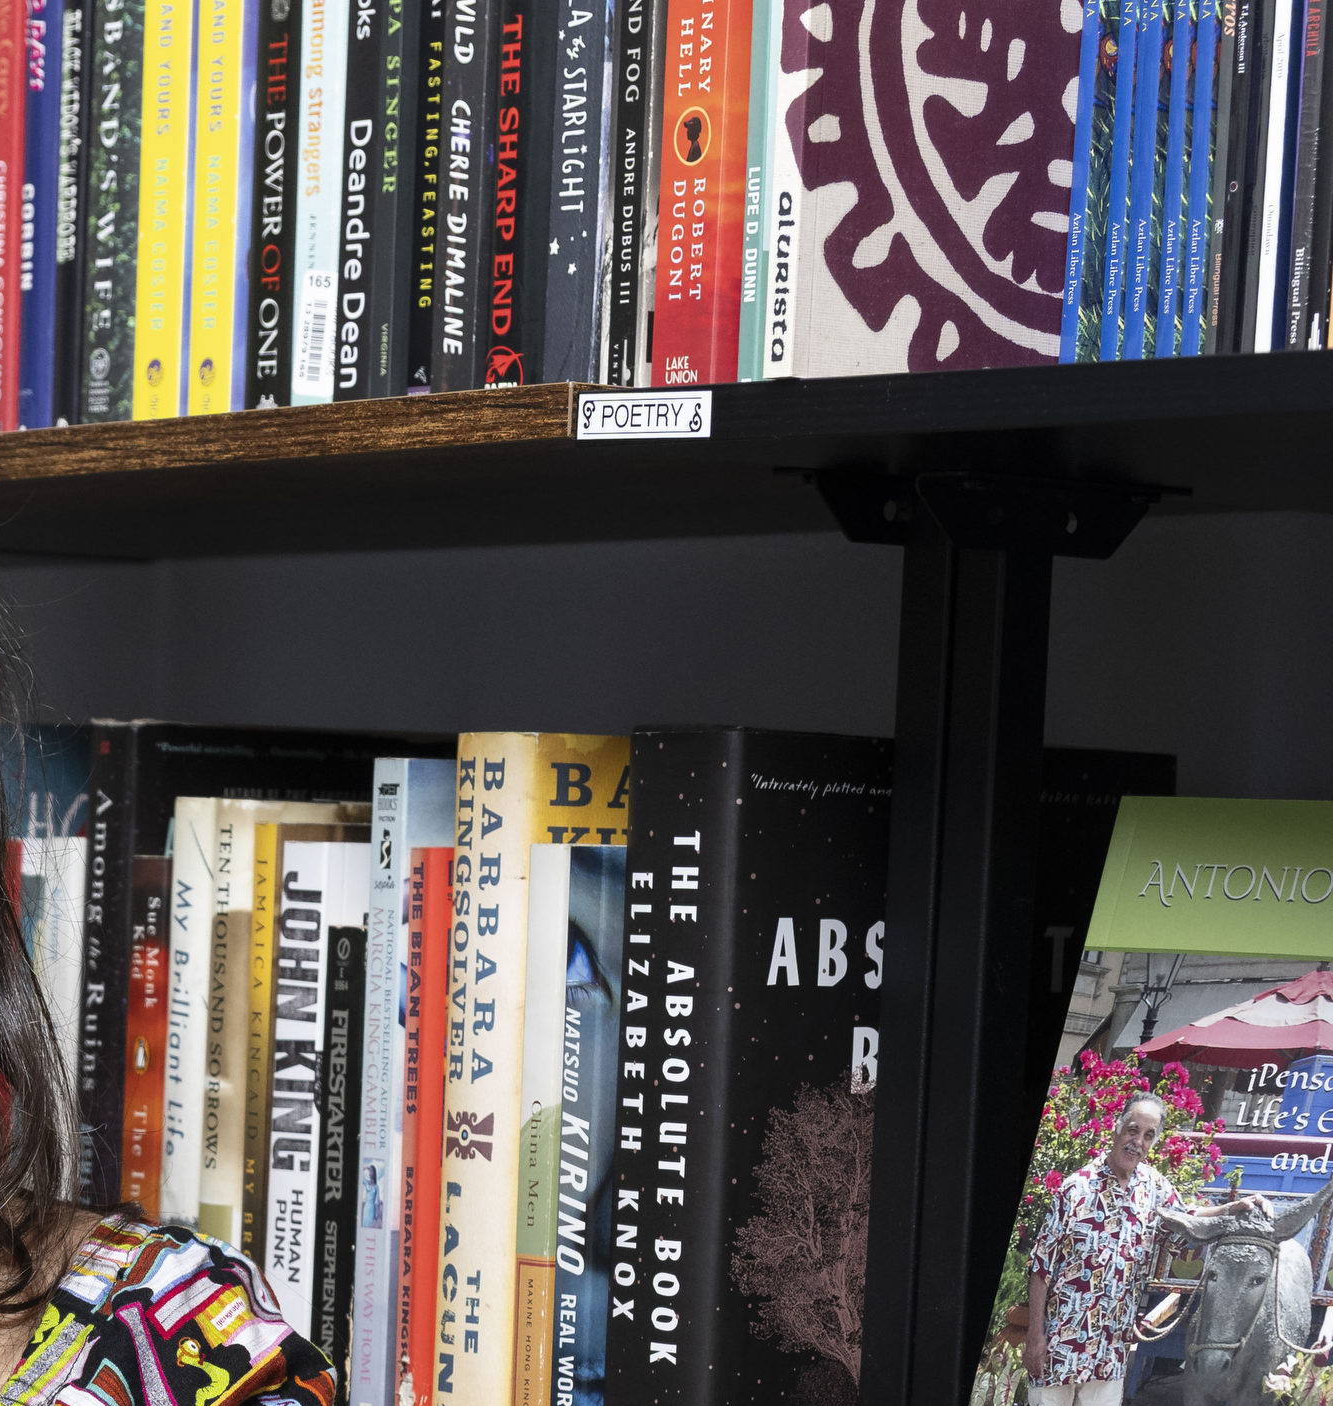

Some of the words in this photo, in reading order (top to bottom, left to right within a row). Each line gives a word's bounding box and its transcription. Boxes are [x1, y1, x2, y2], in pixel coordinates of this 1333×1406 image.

[266, 33, 288, 104] THE
[500, 15, 523, 96] THE
[624, 48, 642, 104] FOG
[677, 18, 694, 97] HELL
[261, 111, 286, 239] POWER
[448, 99, 472, 201] CHERIE
[495, 106, 520, 242] SHARP
[622, 128, 636, 196] ANDRE
[747, 166, 761, 216] LUPE
[344, 119, 373, 281] Deandre
[620, 205, 634, 272] DUBUS
[668, 180, 687, 302] DUGONI
[688, 178, 706, 301] ROBERT
[1071, 212, 1082, 247] Aztlan
[260, 244, 282, 292] OF
[308, 275, 332, 289] 165
[442, 213, 467, 356] DIMALINE
[491, 252, 514, 337] END
[619, 281, 631, 305] III
[743, 248, 758, 303] DUNN
[770, 192, 796, 363] alurista
[1067, 280, 1077, 305] Press
[1069, 249, 1079, 279] Libre
[256, 298, 280, 379] ONE
[338, 293, 366, 389] Dean
[665, 370, 698, 384] UNION
[666, 356, 689, 370] LAKE
[601, 403, 683, 428] POETRY
[669, 830, 701, 923] THE
[1138, 860, 1332, 908] ANTONIO
[279, 871, 323, 1024] JOHN
[448, 757, 476, 1084] KINGSOLVER
[471, 757, 506, 1084] BARBARA
[620, 872, 654, 1152] ELIZABETH
[562, 1006, 582, 1103] NATSUO
[656, 961, 695, 1207] ABSOLUTE
[271, 1039, 318, 1172] KING
[1236, 1099, 1311, 1132] Life's
[555, 1115, 590, 1277] KIRINO
[1270, 1144, 1332, 1175] and
[273, 1199, 288, 1269] PUNK
[287, 1189, 304, 1283] HUMAN
[613, 1189, 640, 1321] KNOX
[463, 1270, 482, 1355] THE
[559, 1294, 577, 1348] REAL
[649, 1238, 682, 1366] BOOK
